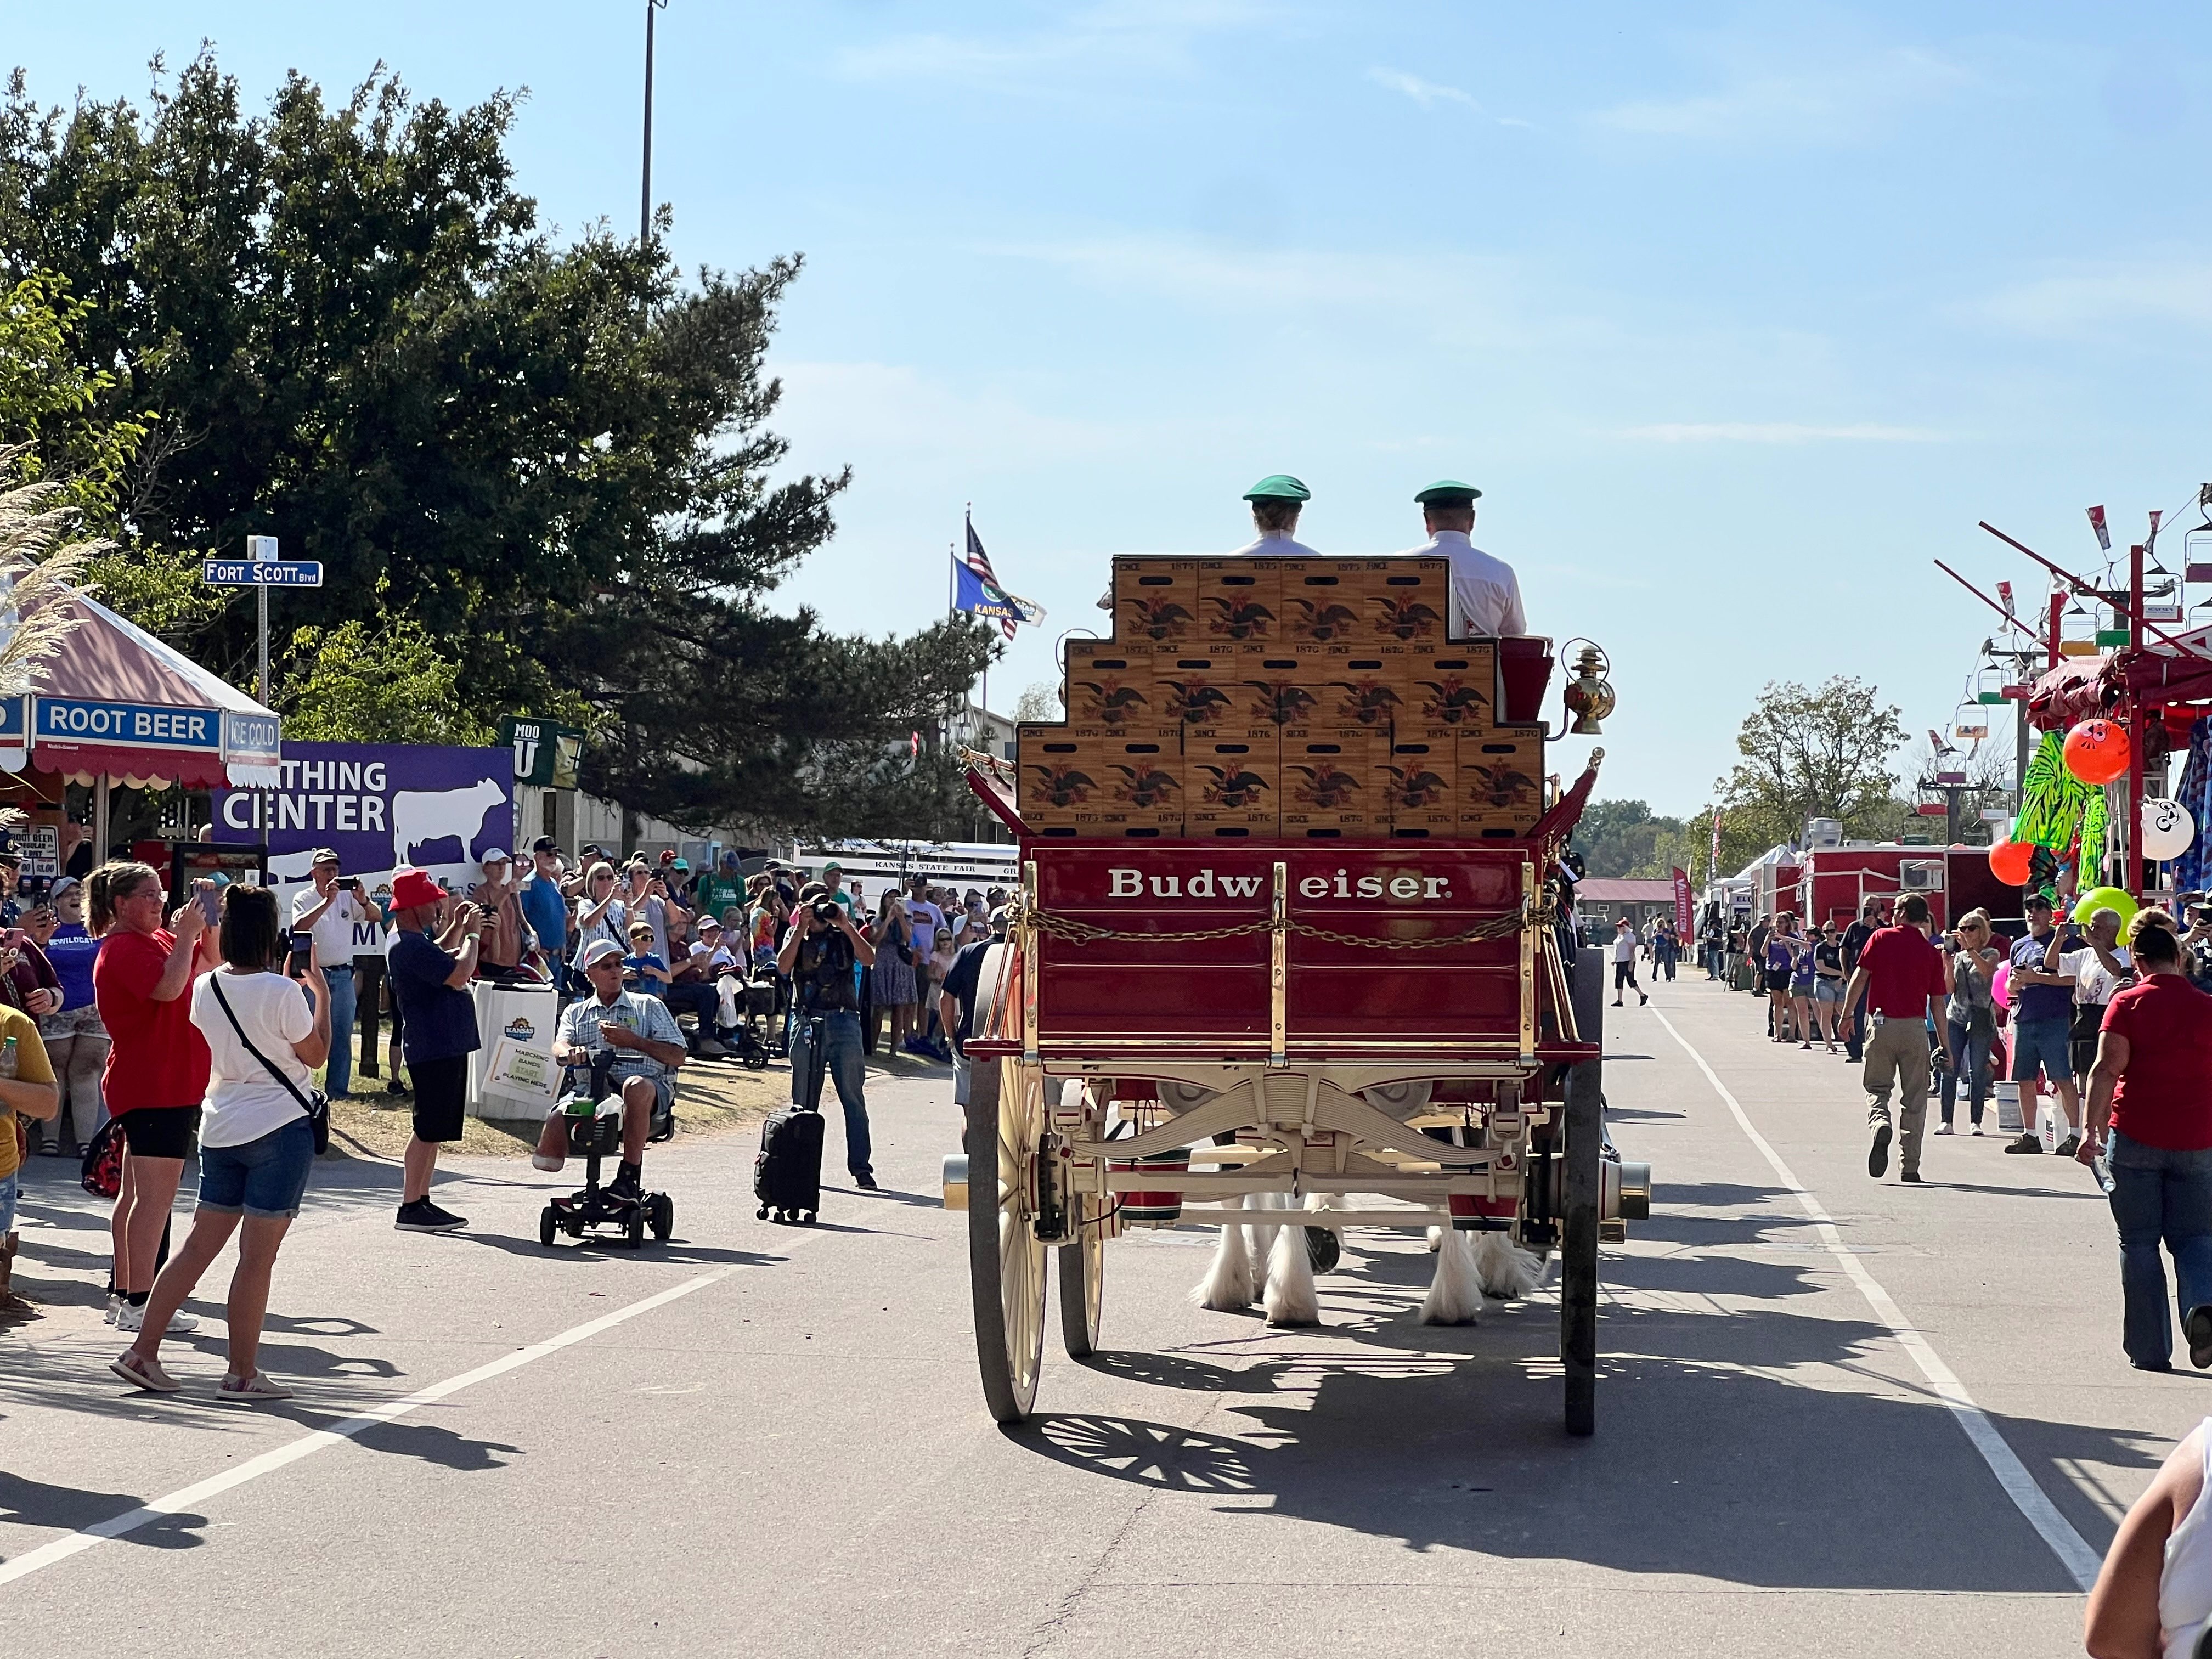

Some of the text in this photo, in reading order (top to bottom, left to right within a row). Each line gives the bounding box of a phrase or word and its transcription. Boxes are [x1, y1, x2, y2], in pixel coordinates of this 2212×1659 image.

[207, 563, 315, 582] FORT SCOTT Blvd
[974, 603, 1014, 617] KANSAS
[50, 706, 206, 740] ROOT BEER
[515, 724, 540, 738] MOO
[232, 721, 274, 746] ICE COLD
[514, 740, 538, 778] U
[281, 760, 386, 791] THING
[223, 792, 385, 831] CENTER
[516, 1049, 549, 1062] MARCHING
[518, 1058, 541, 1068] BANDS
[503, 1072, 548, 1089] PLAYING HERE
[516, 1066, 539, 1077] START
